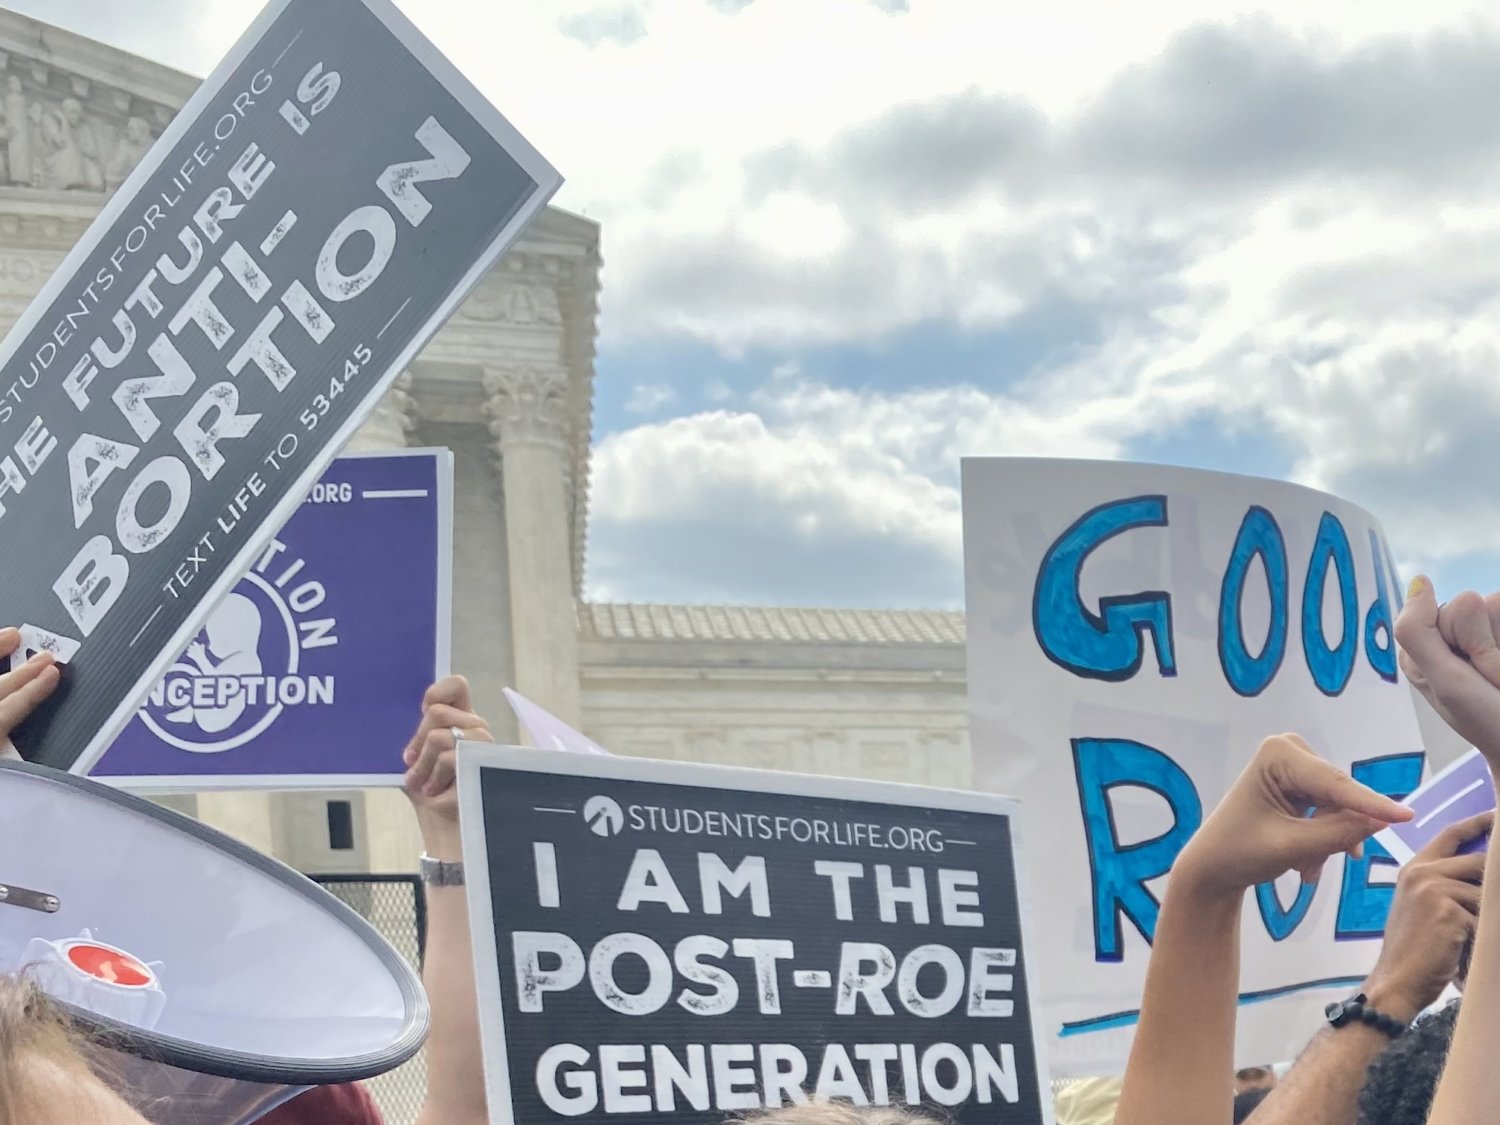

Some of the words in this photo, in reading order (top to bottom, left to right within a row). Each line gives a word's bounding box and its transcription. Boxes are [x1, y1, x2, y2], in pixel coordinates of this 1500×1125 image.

[0, 415, 58, 519] HE
[62, 142, 276, 412] FUTURE
[278, 61, 342, 136] IS
[67, 209, 298, 530] ANTI-
[163, 532, 215, 598] TEXT
[216, 472, 267, 534] LIFE
[264, 434, 299, 470] TO
[300, 345, 373, 431] 53445
[628, 804, 945, 853] STUDENTSFORLIFE.ORG
[533, 842, 560, 908] I
[616, 848, 772, 917] AM
[814, 859, 985, 928] THE
[511, 930, 1018, 1018] POST-ROE
[535, 1042, 1020, 1117] GENERATION
